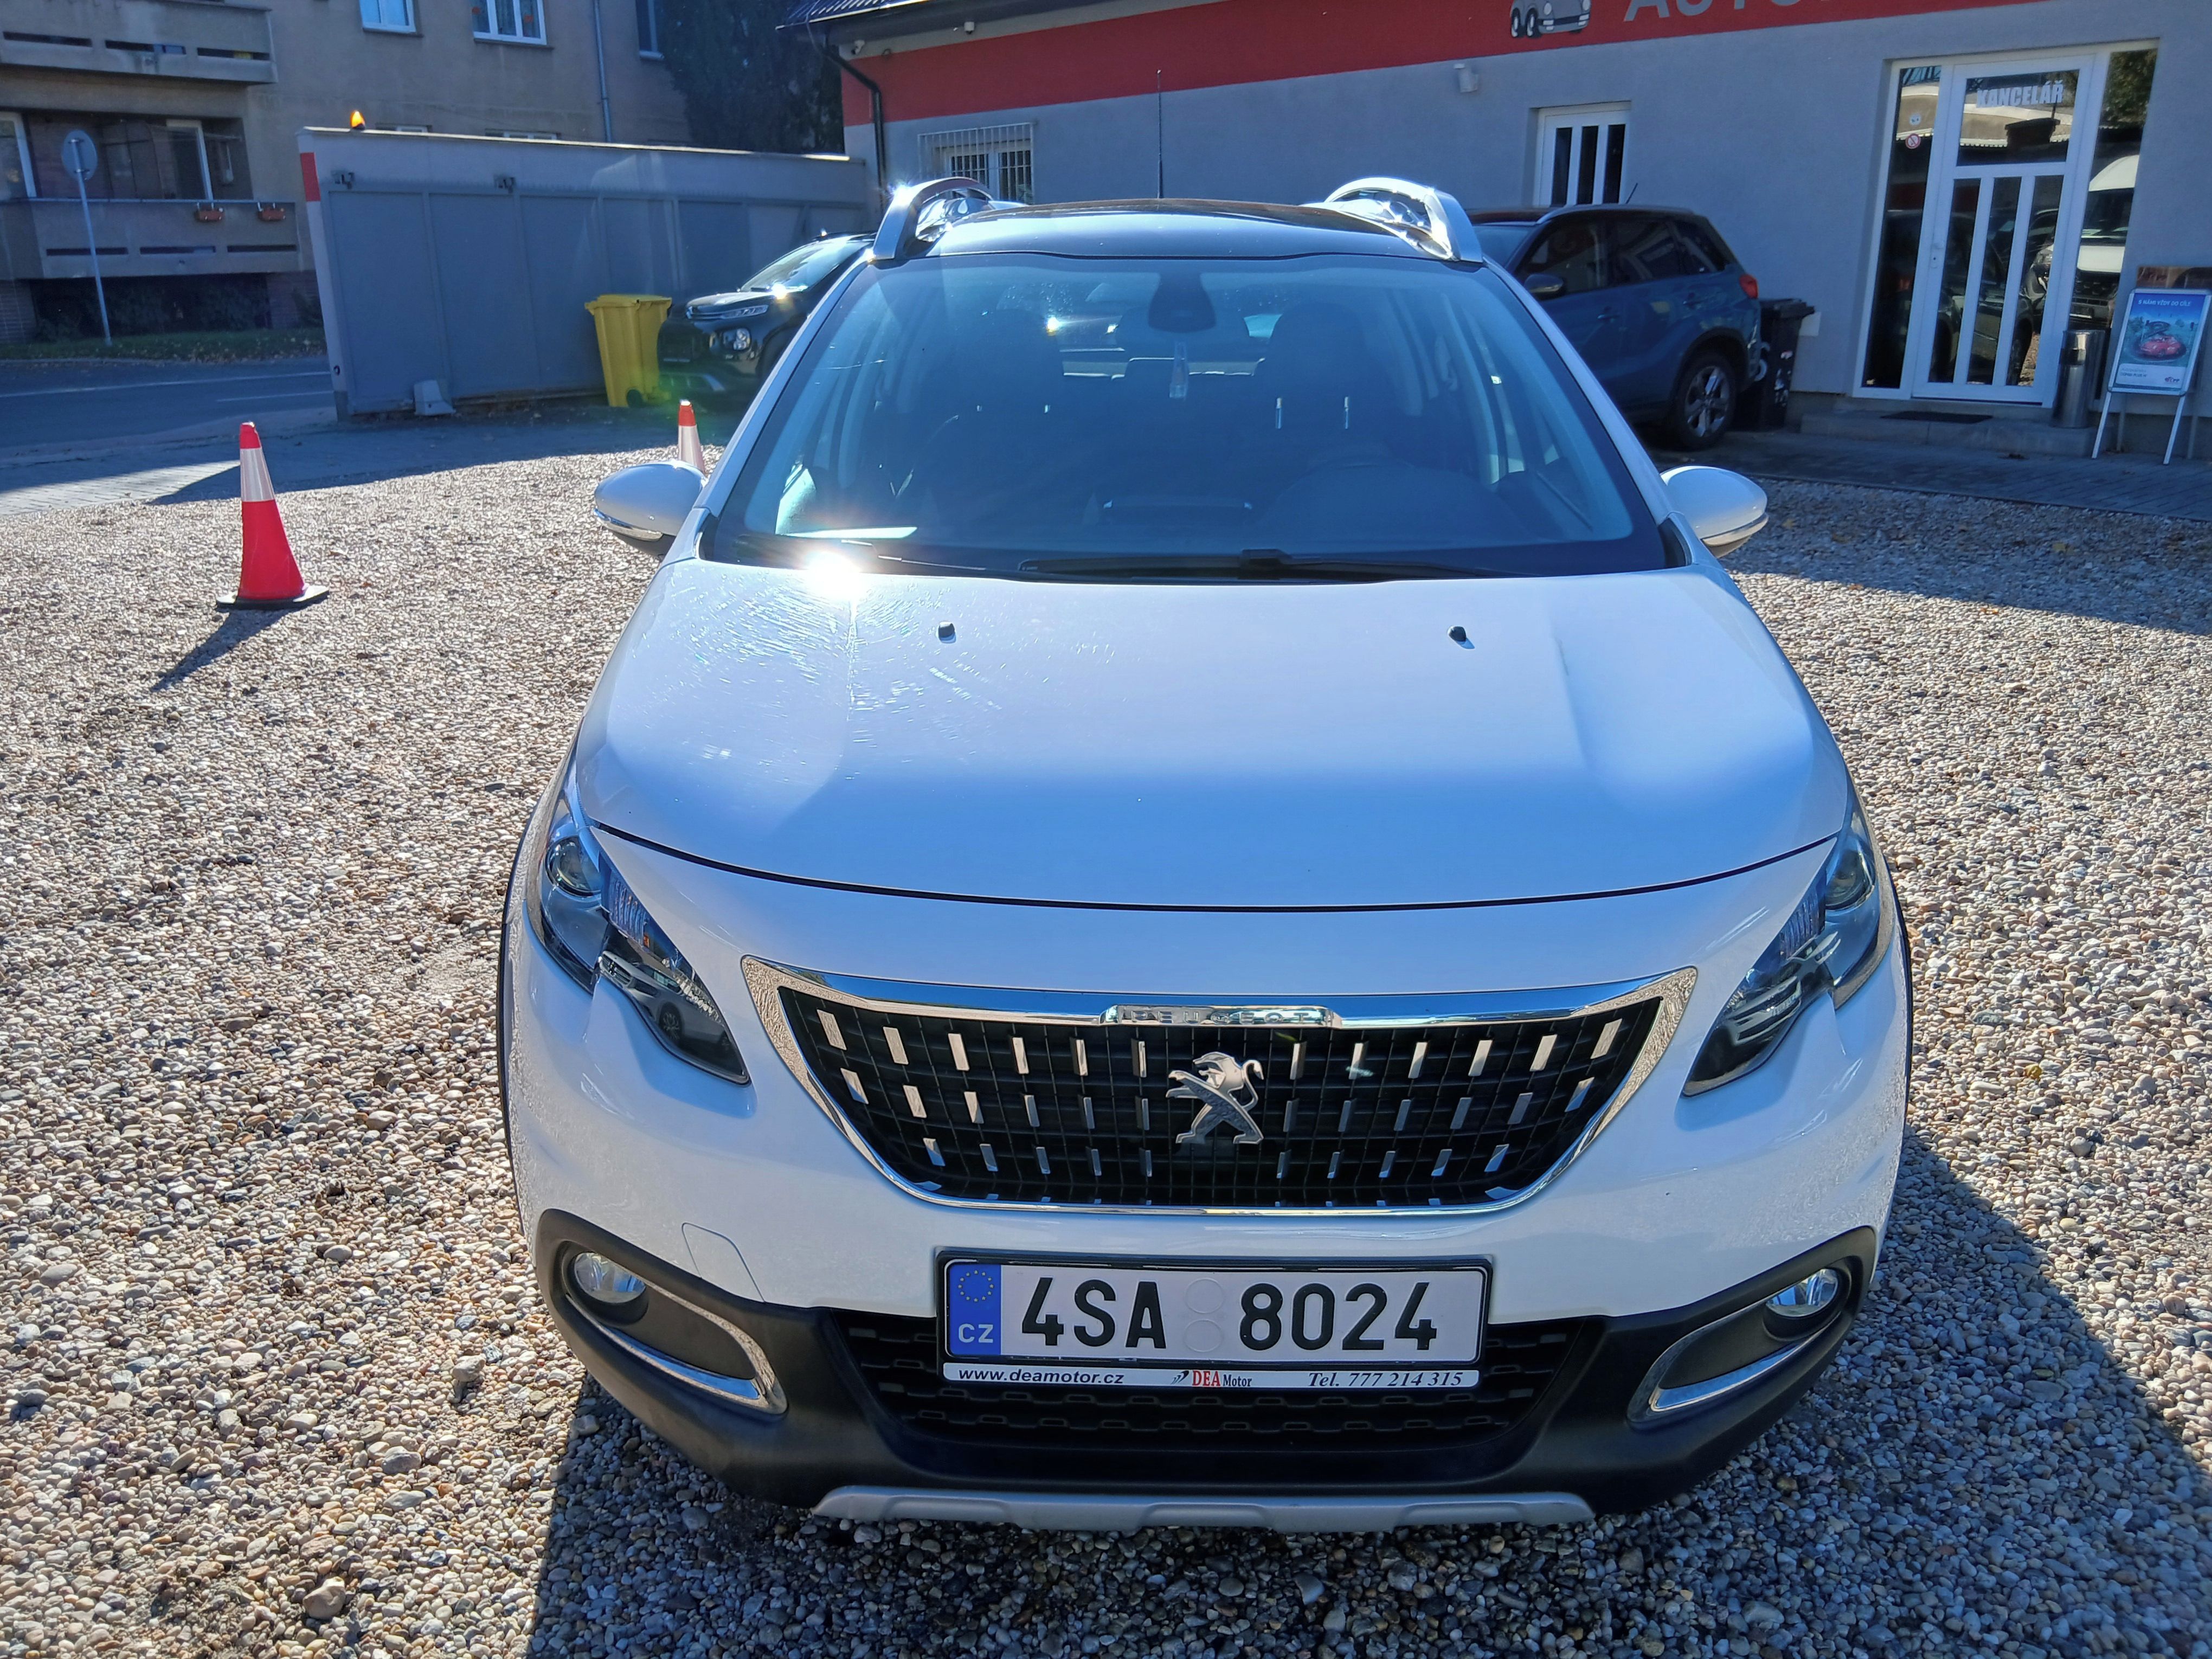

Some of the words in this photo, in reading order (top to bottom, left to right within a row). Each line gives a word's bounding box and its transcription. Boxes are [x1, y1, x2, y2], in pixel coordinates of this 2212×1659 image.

[1976, 80, 2063, 108] KANCELÁŘ
[1131, 1010, 1310, 1025] PEUGEOT
[1021, 1277, 1167, 1349] 4SA
[1239, 1282, 1437, 1351] 8024
[958, 1323, 993, 1343] CZ
[959, 1368, 1125, 1384] www.deamotor.cz
[1192, 1371, 1220, 1387] DEA
[1223, 1374, 1252, 1387] Motor
[1308, 1372, 1340, 1386] Tel.
[1348, 1372, 1383, 1386] 777
[1387, 1372, 1424, 1386] 214
[1427, 1372, 1463, 1386] 315
